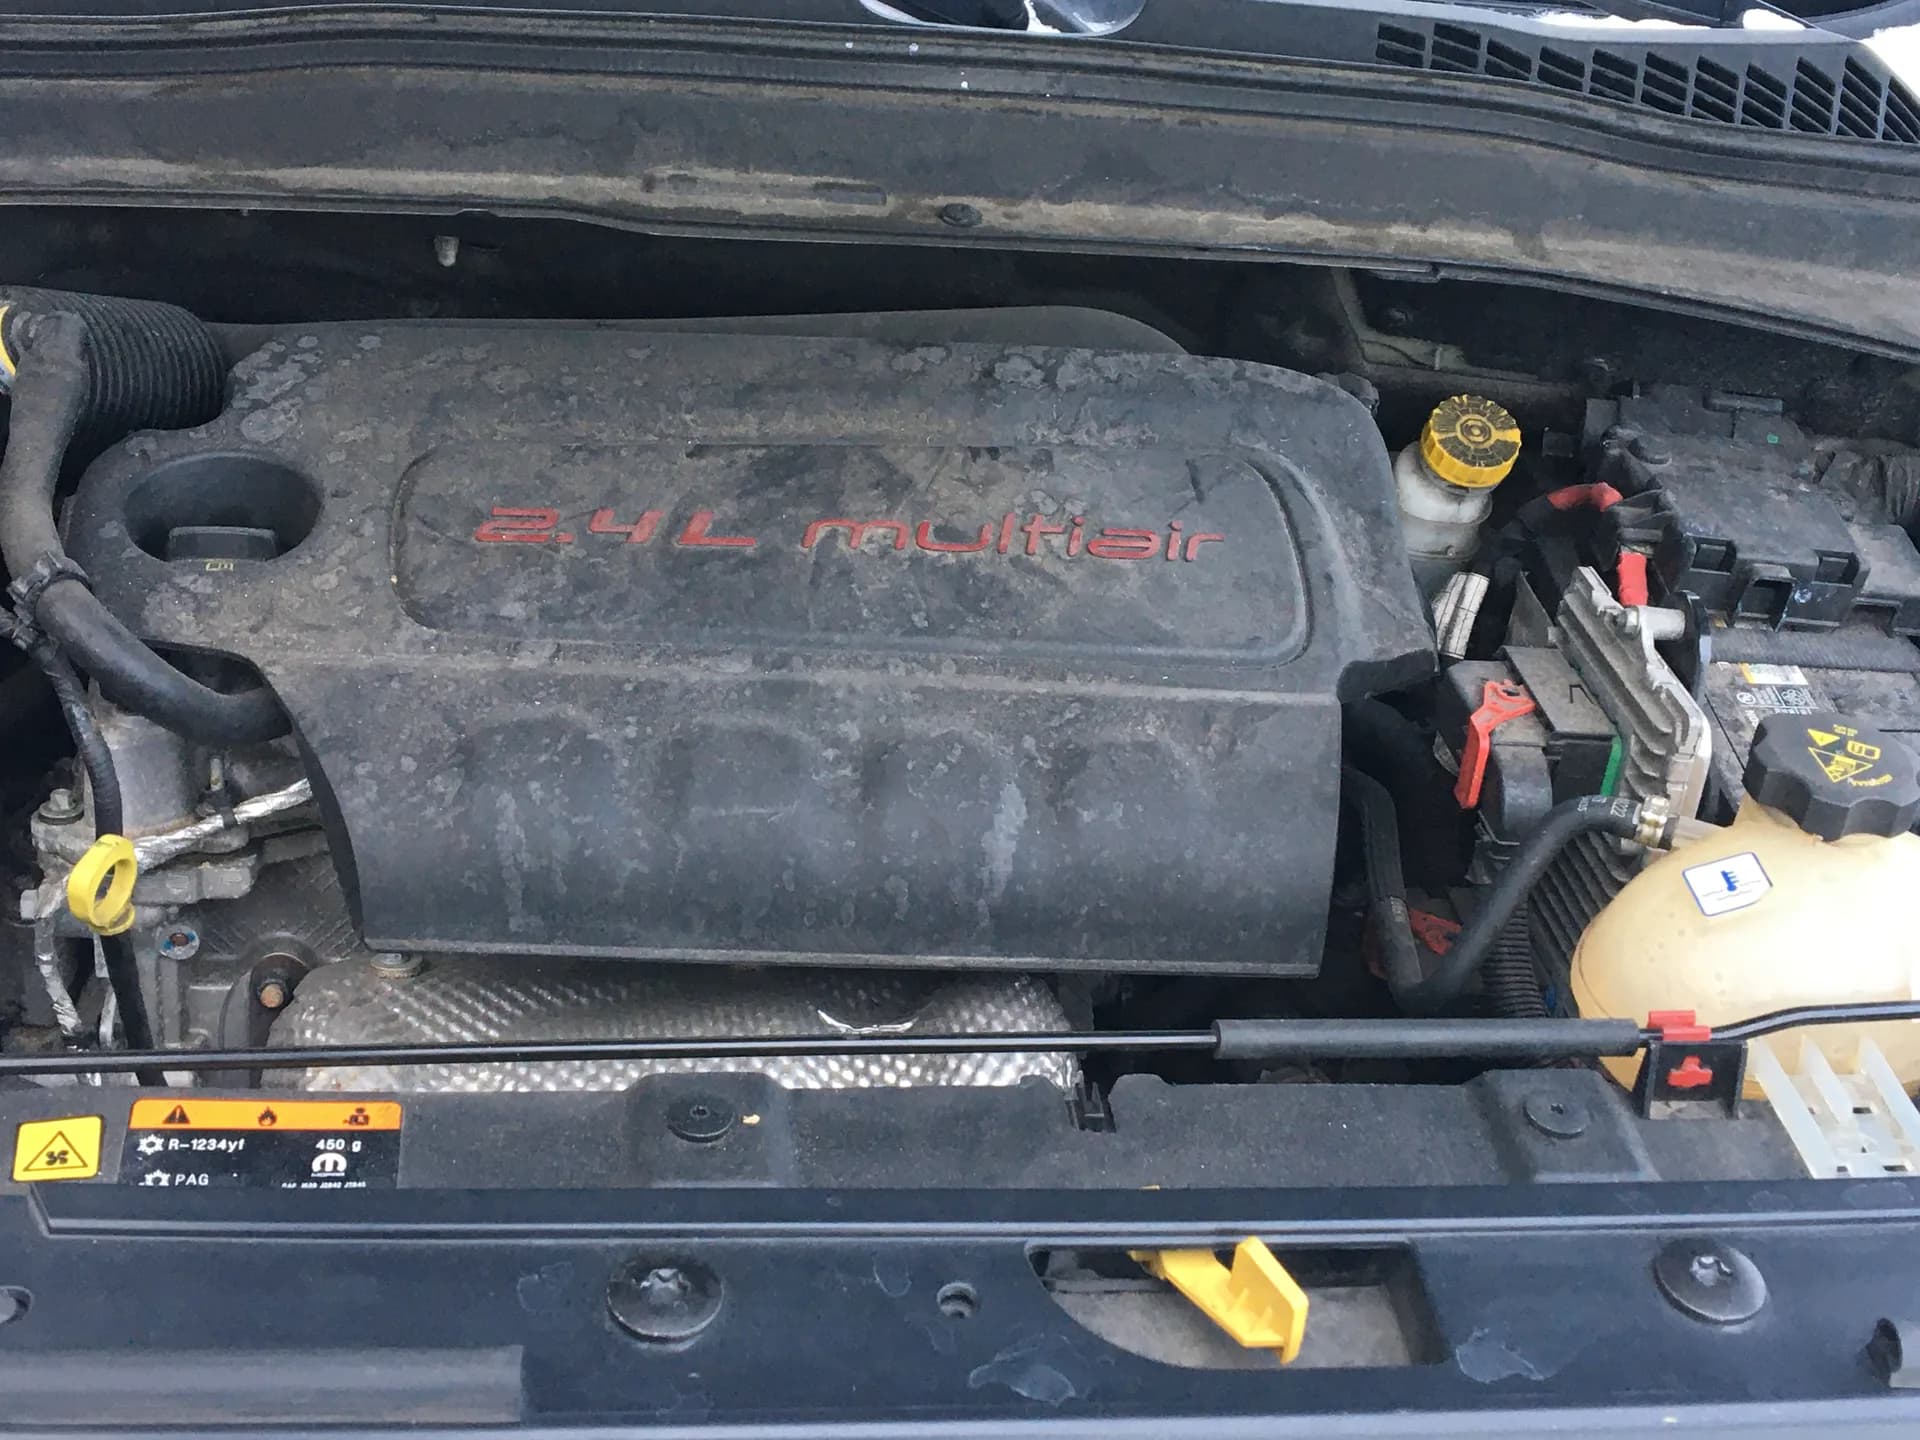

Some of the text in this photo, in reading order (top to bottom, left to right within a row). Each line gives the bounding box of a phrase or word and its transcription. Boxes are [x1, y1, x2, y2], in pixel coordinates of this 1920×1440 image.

[804, 518, 1224, 562] multiair
[168, 1138, 245, 1153] R-1234yf
[315, 1138, 362, 1153] 450 g
[175, 1173, 209, 1186] PAG
